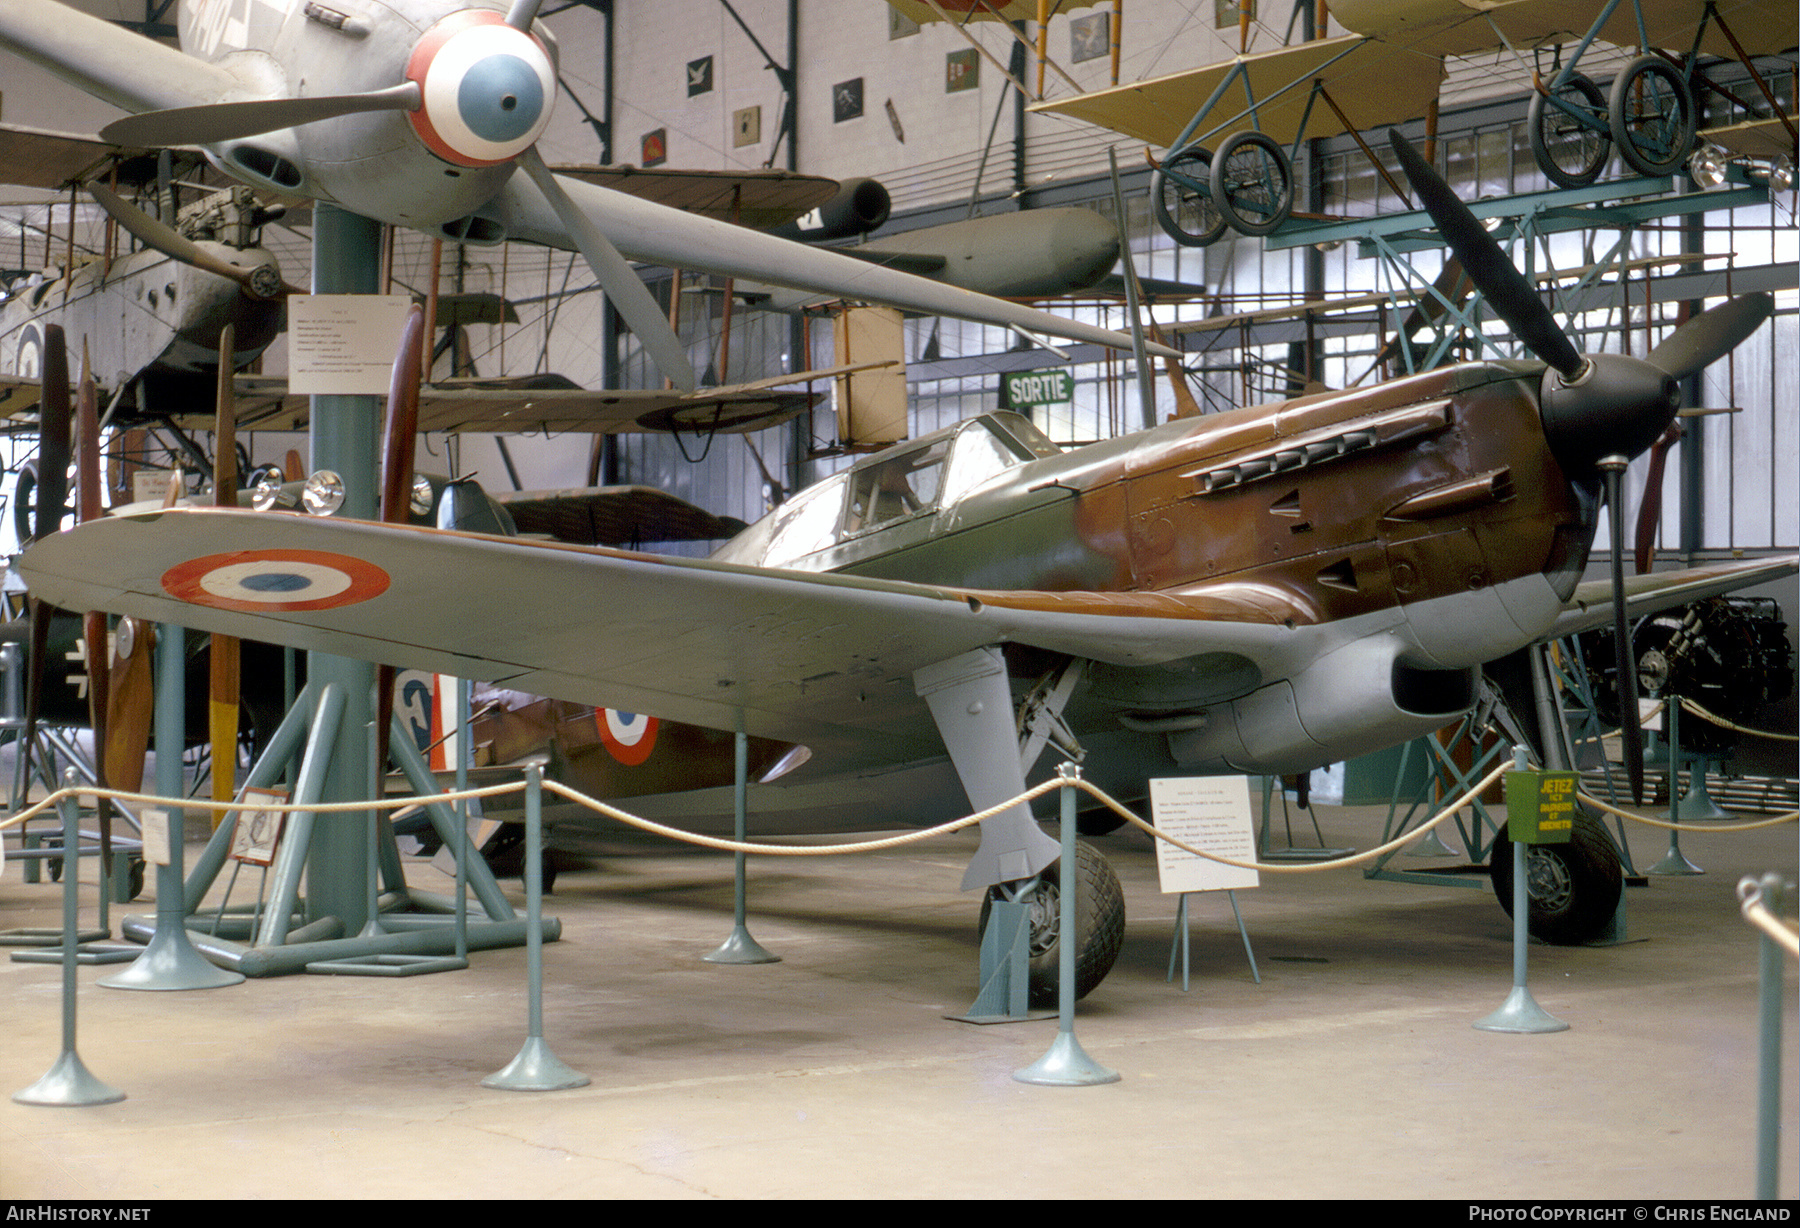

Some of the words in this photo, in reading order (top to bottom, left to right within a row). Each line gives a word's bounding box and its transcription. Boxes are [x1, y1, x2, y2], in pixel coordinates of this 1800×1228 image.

[1009, 373, 1068, 404] SORTIE
[1540, 778, 1574, 794] JETEZ
[1549, 793, 1563, 802] ICI
